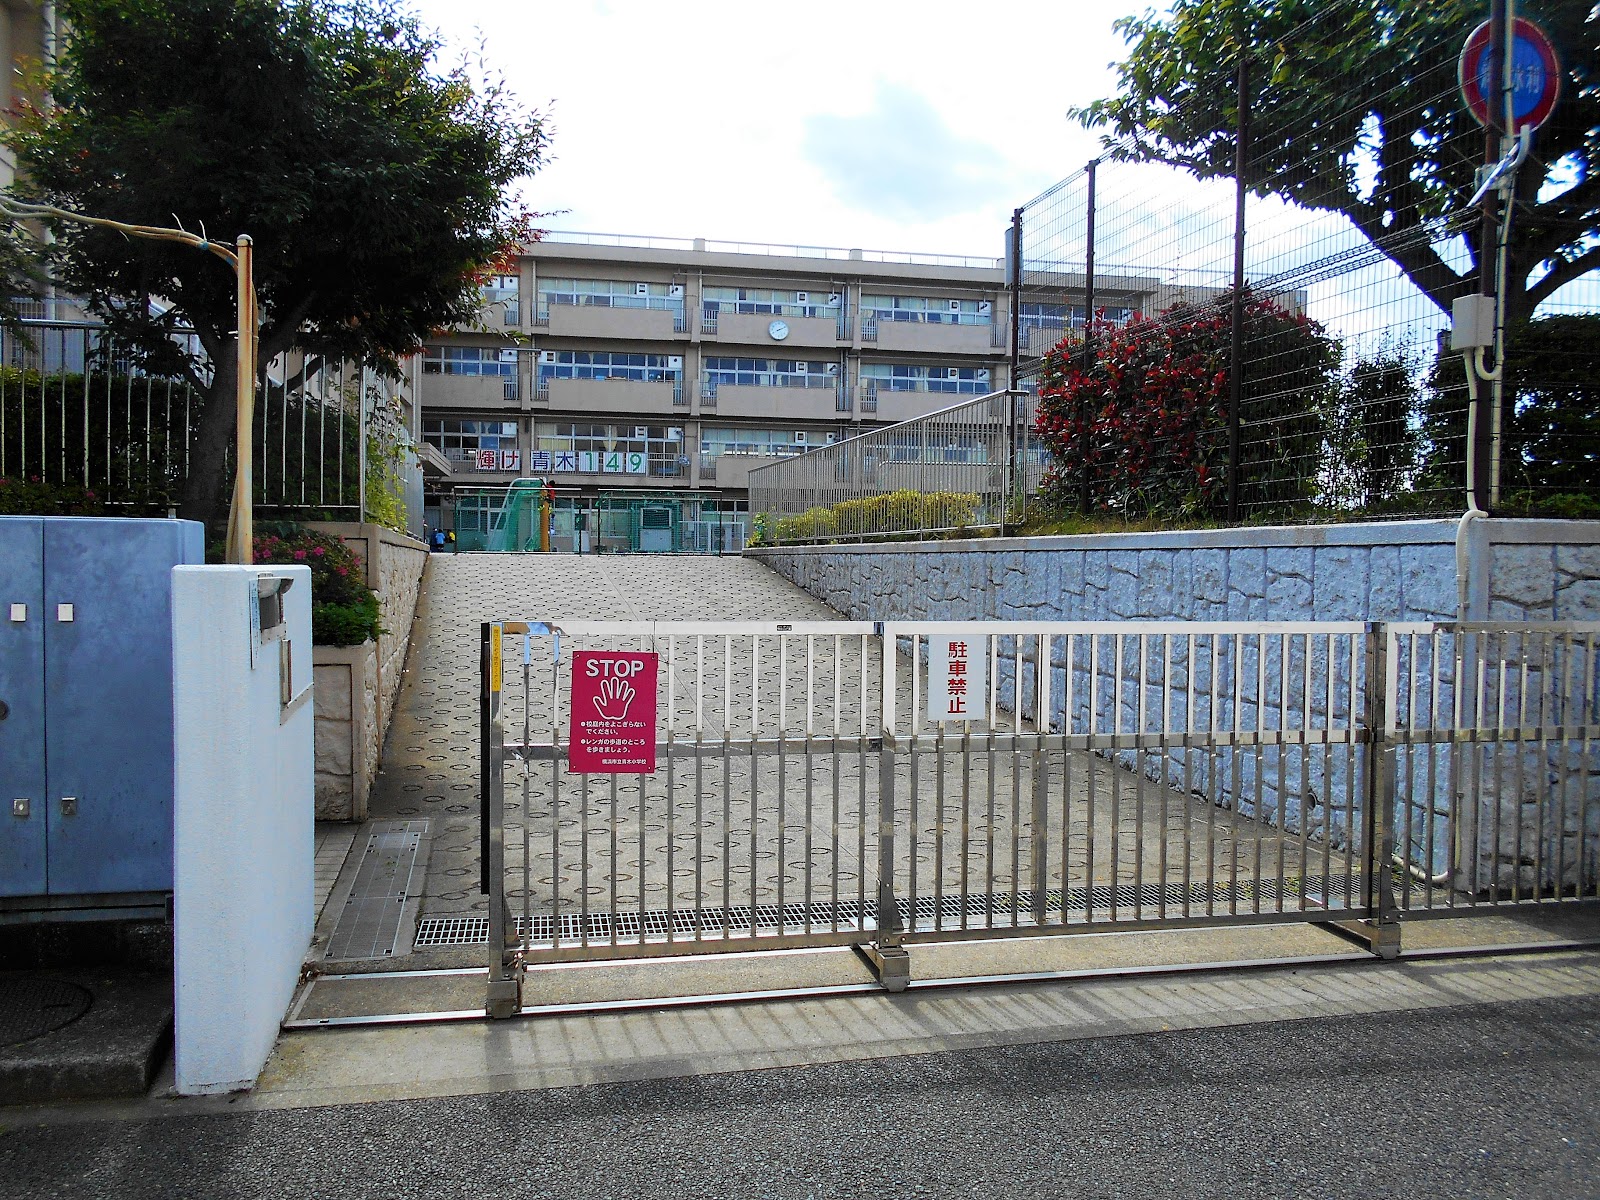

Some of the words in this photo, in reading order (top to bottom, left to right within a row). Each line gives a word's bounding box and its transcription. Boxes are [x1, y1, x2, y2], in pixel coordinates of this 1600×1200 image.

[476, 451, 519, 469] 輝け
[585, 659, 644, 677] STOP
[947, 641, 968, 713] 駐車禁止
